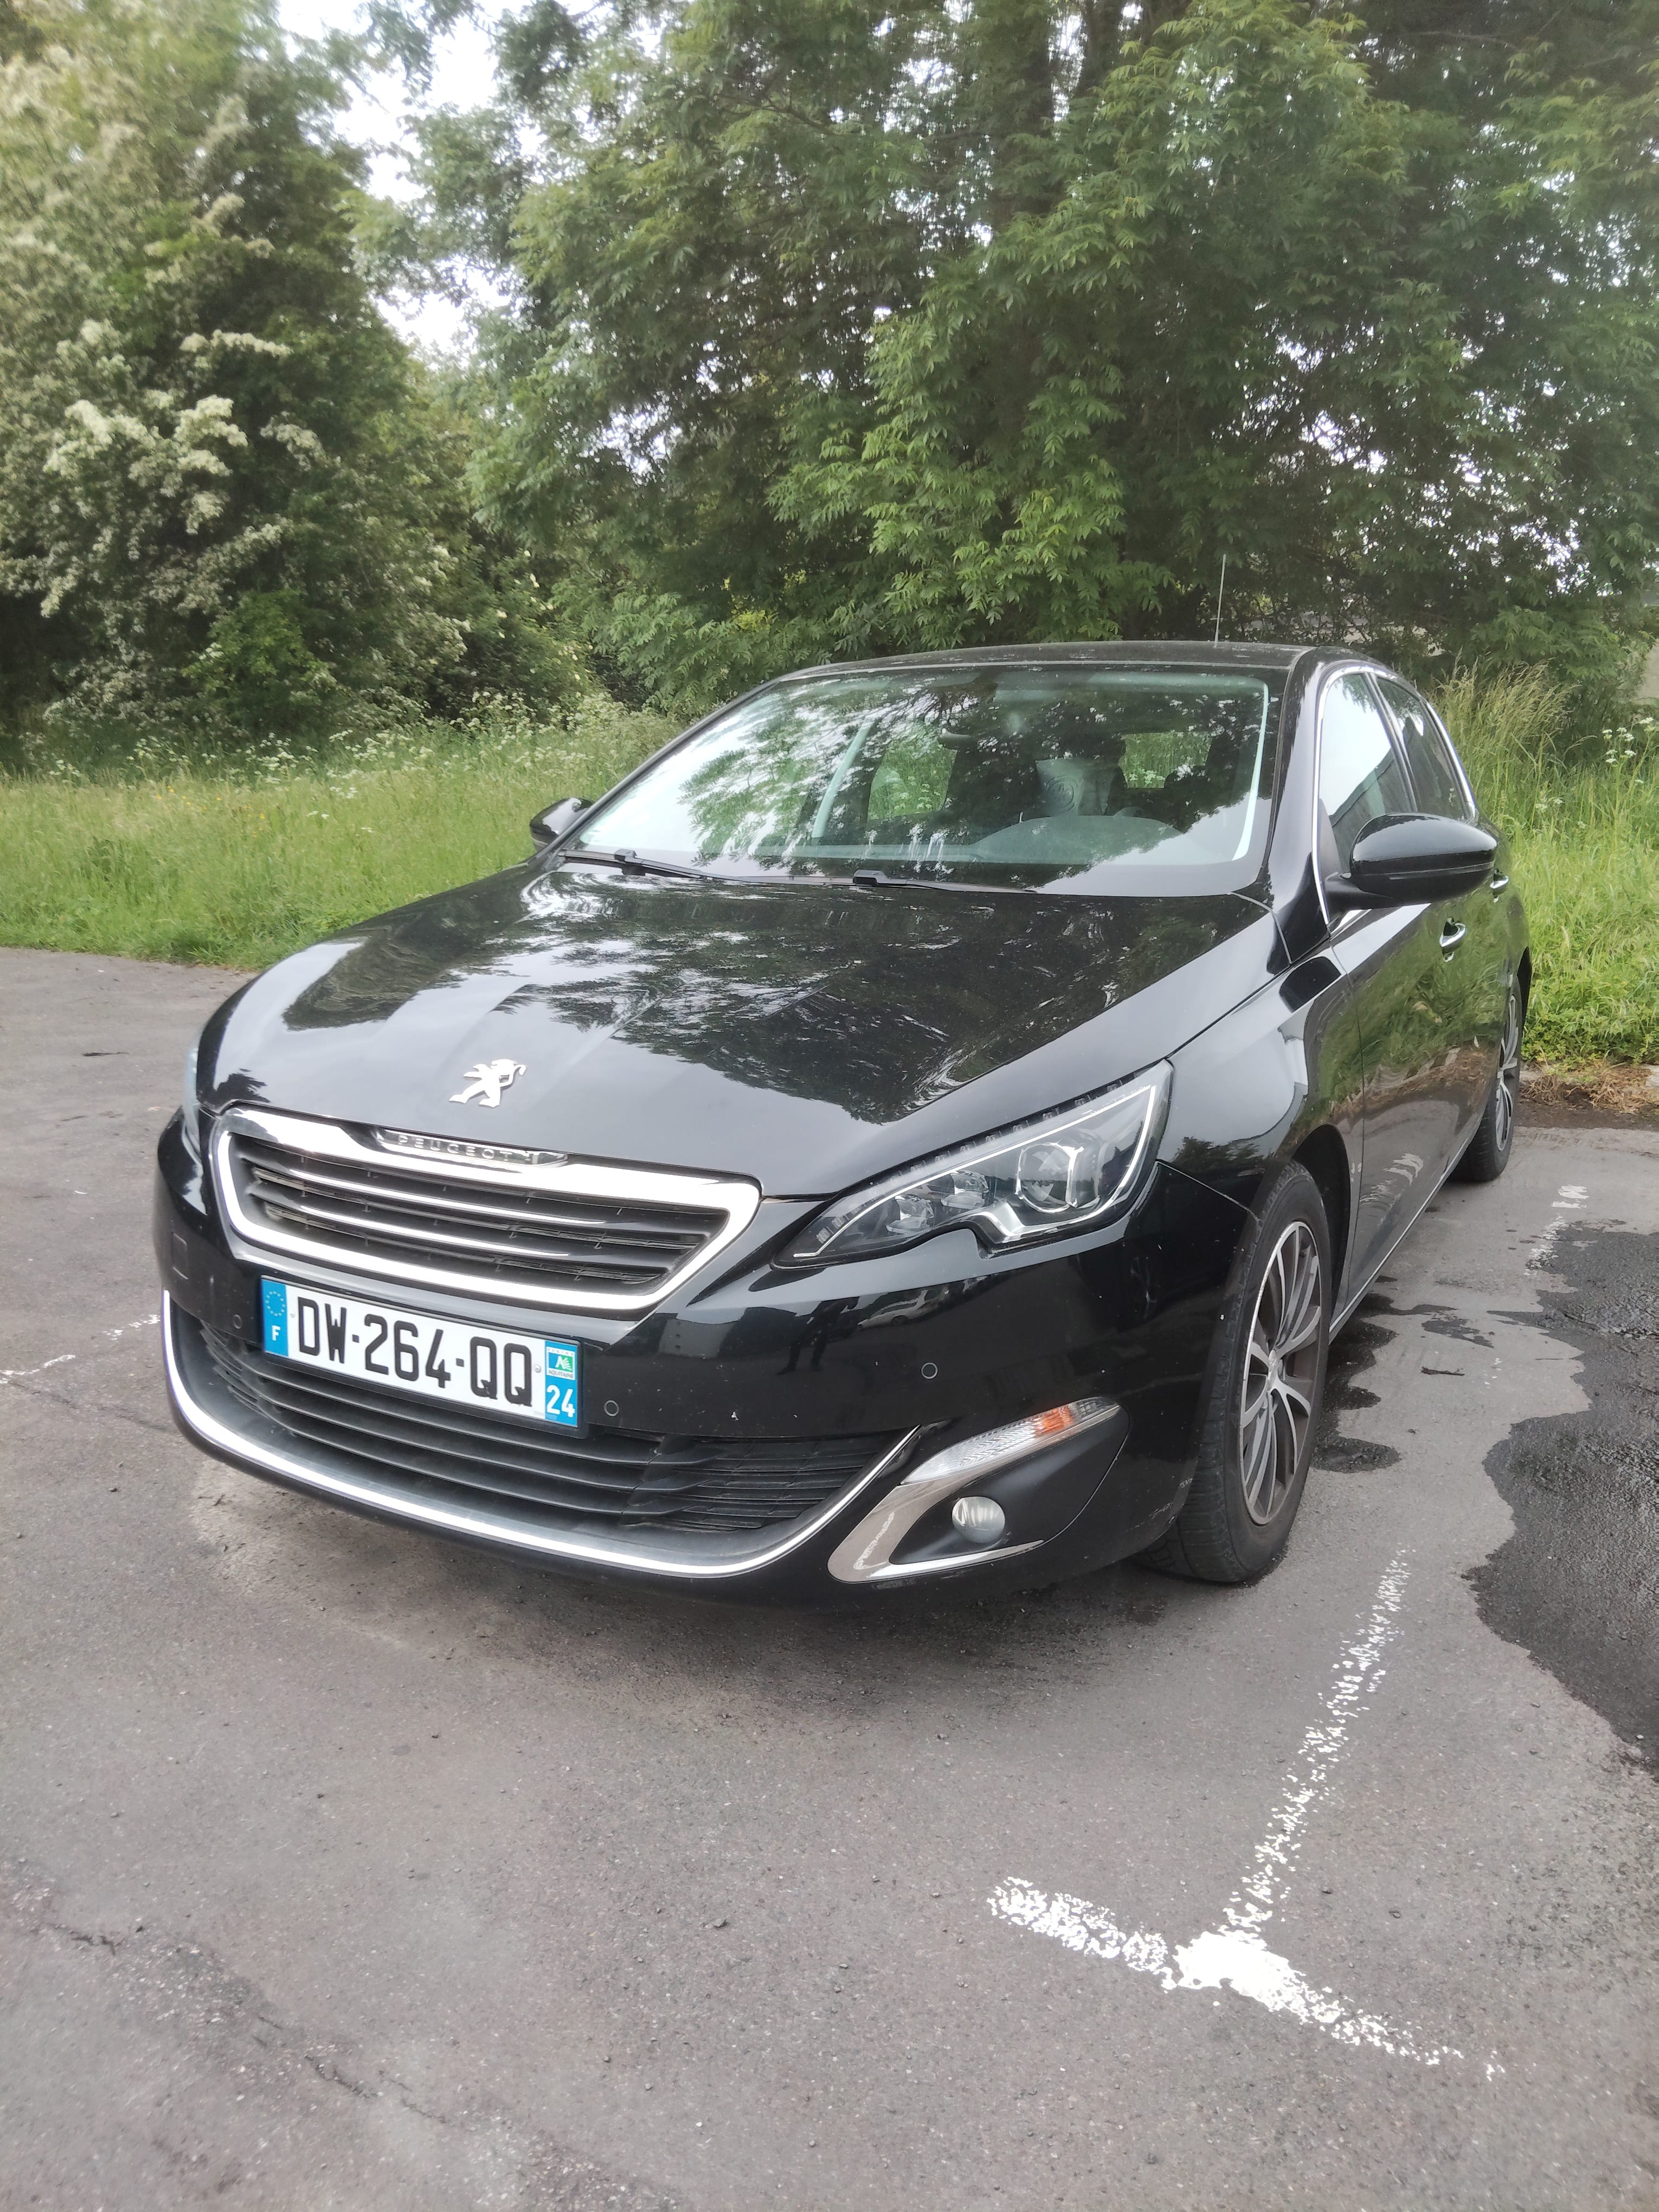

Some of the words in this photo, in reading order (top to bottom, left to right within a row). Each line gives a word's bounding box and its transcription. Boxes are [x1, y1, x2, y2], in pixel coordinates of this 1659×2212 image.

[398, 1134, 512, 1161] PEUGEOT
[272, 1324, 281, 1341] F
[298, 1296, 533, 1407] DW-264-QQ
[548, 1369, 574, 1379] AQUITAINE
[546, 1385, 575, 1418] 24
